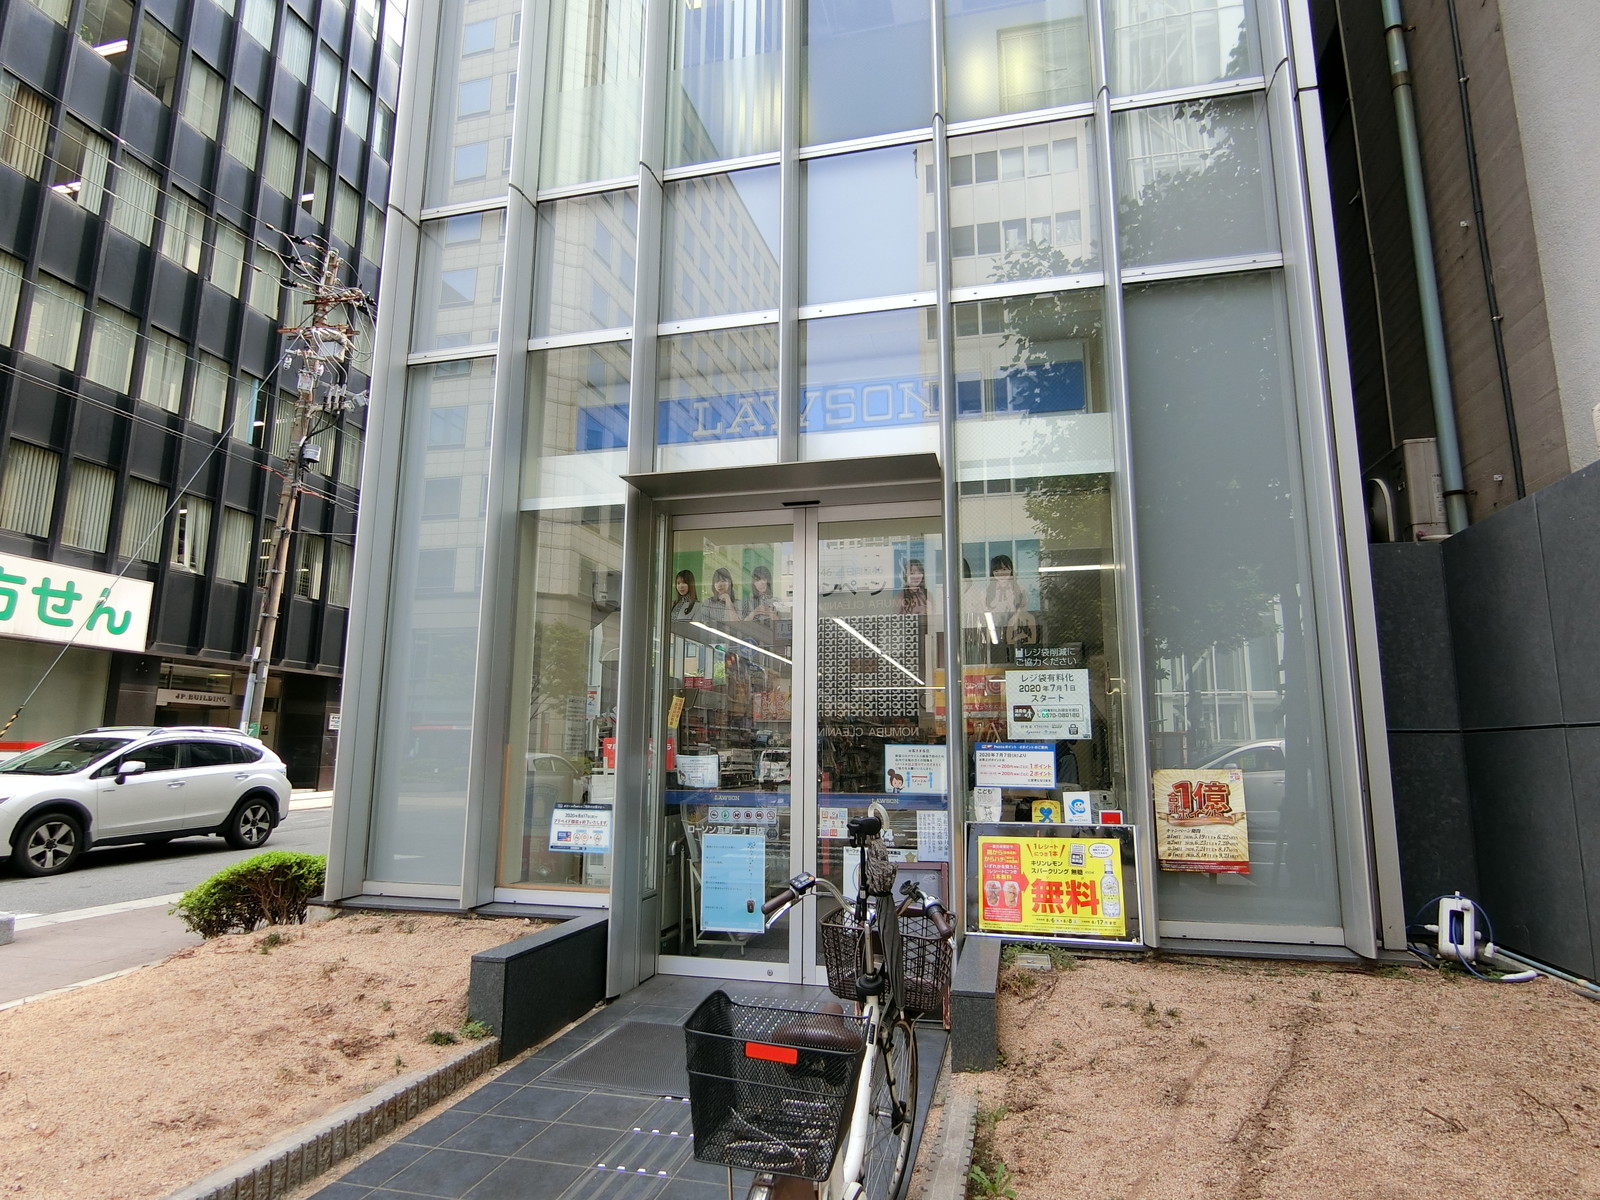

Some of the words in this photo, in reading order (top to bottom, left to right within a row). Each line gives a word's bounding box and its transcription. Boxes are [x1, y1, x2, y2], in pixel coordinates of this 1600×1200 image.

[693, 380, 940, 437] LAWSON
[1024, 647, 1076, 657] レジ袋削減に
[1016, 657, 1077, 667] ご協力ください
[1021, 673, 1074, 682] レジ袋有料化
[1031, 693, 1065, 702] スタート
[1031, 878, 1100, 916] 無料
